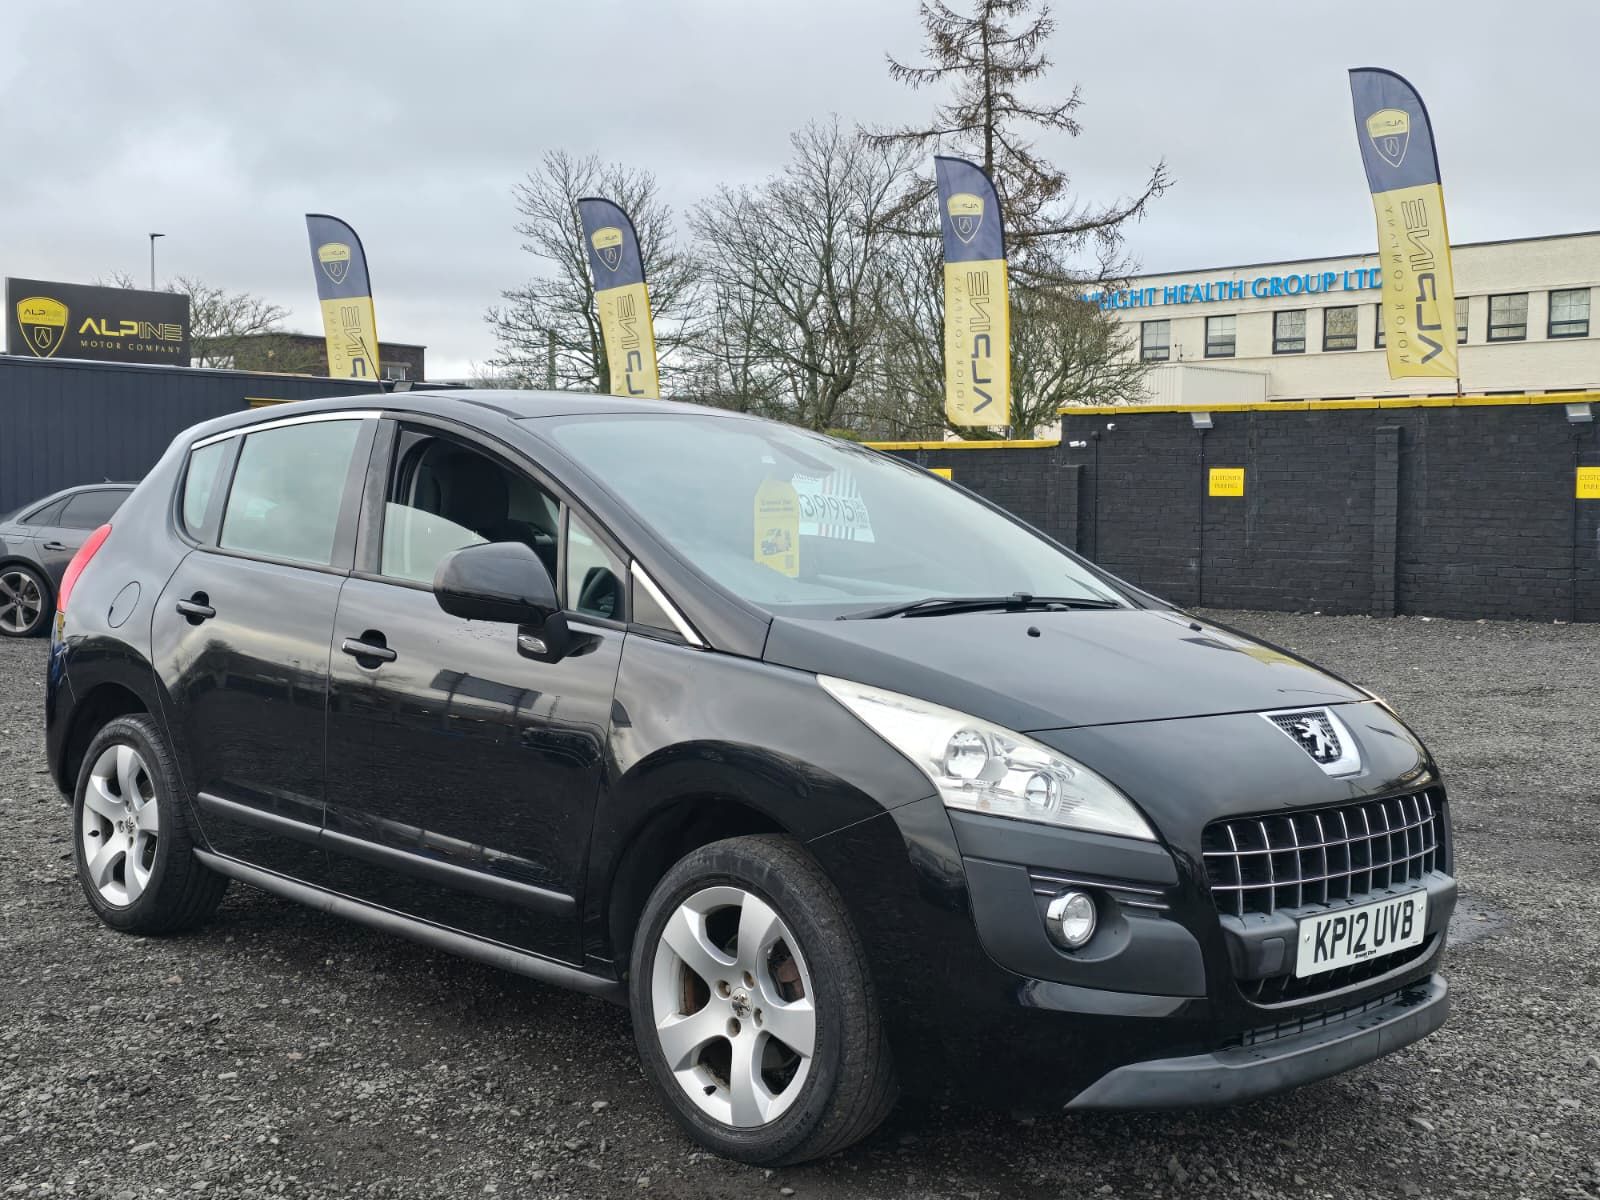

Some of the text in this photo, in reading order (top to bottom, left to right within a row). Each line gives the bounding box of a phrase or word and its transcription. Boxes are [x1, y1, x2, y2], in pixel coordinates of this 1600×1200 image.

[1163, 280, 1244, 304] HEALTH
[1252, 270, 1338, 298] GROUP
[78, 317, 183, 341] ALPINE
[80, 340, 181, 354] MOTOR COMPANY
[1313, 899, 1415, 964] KP12 UVB
